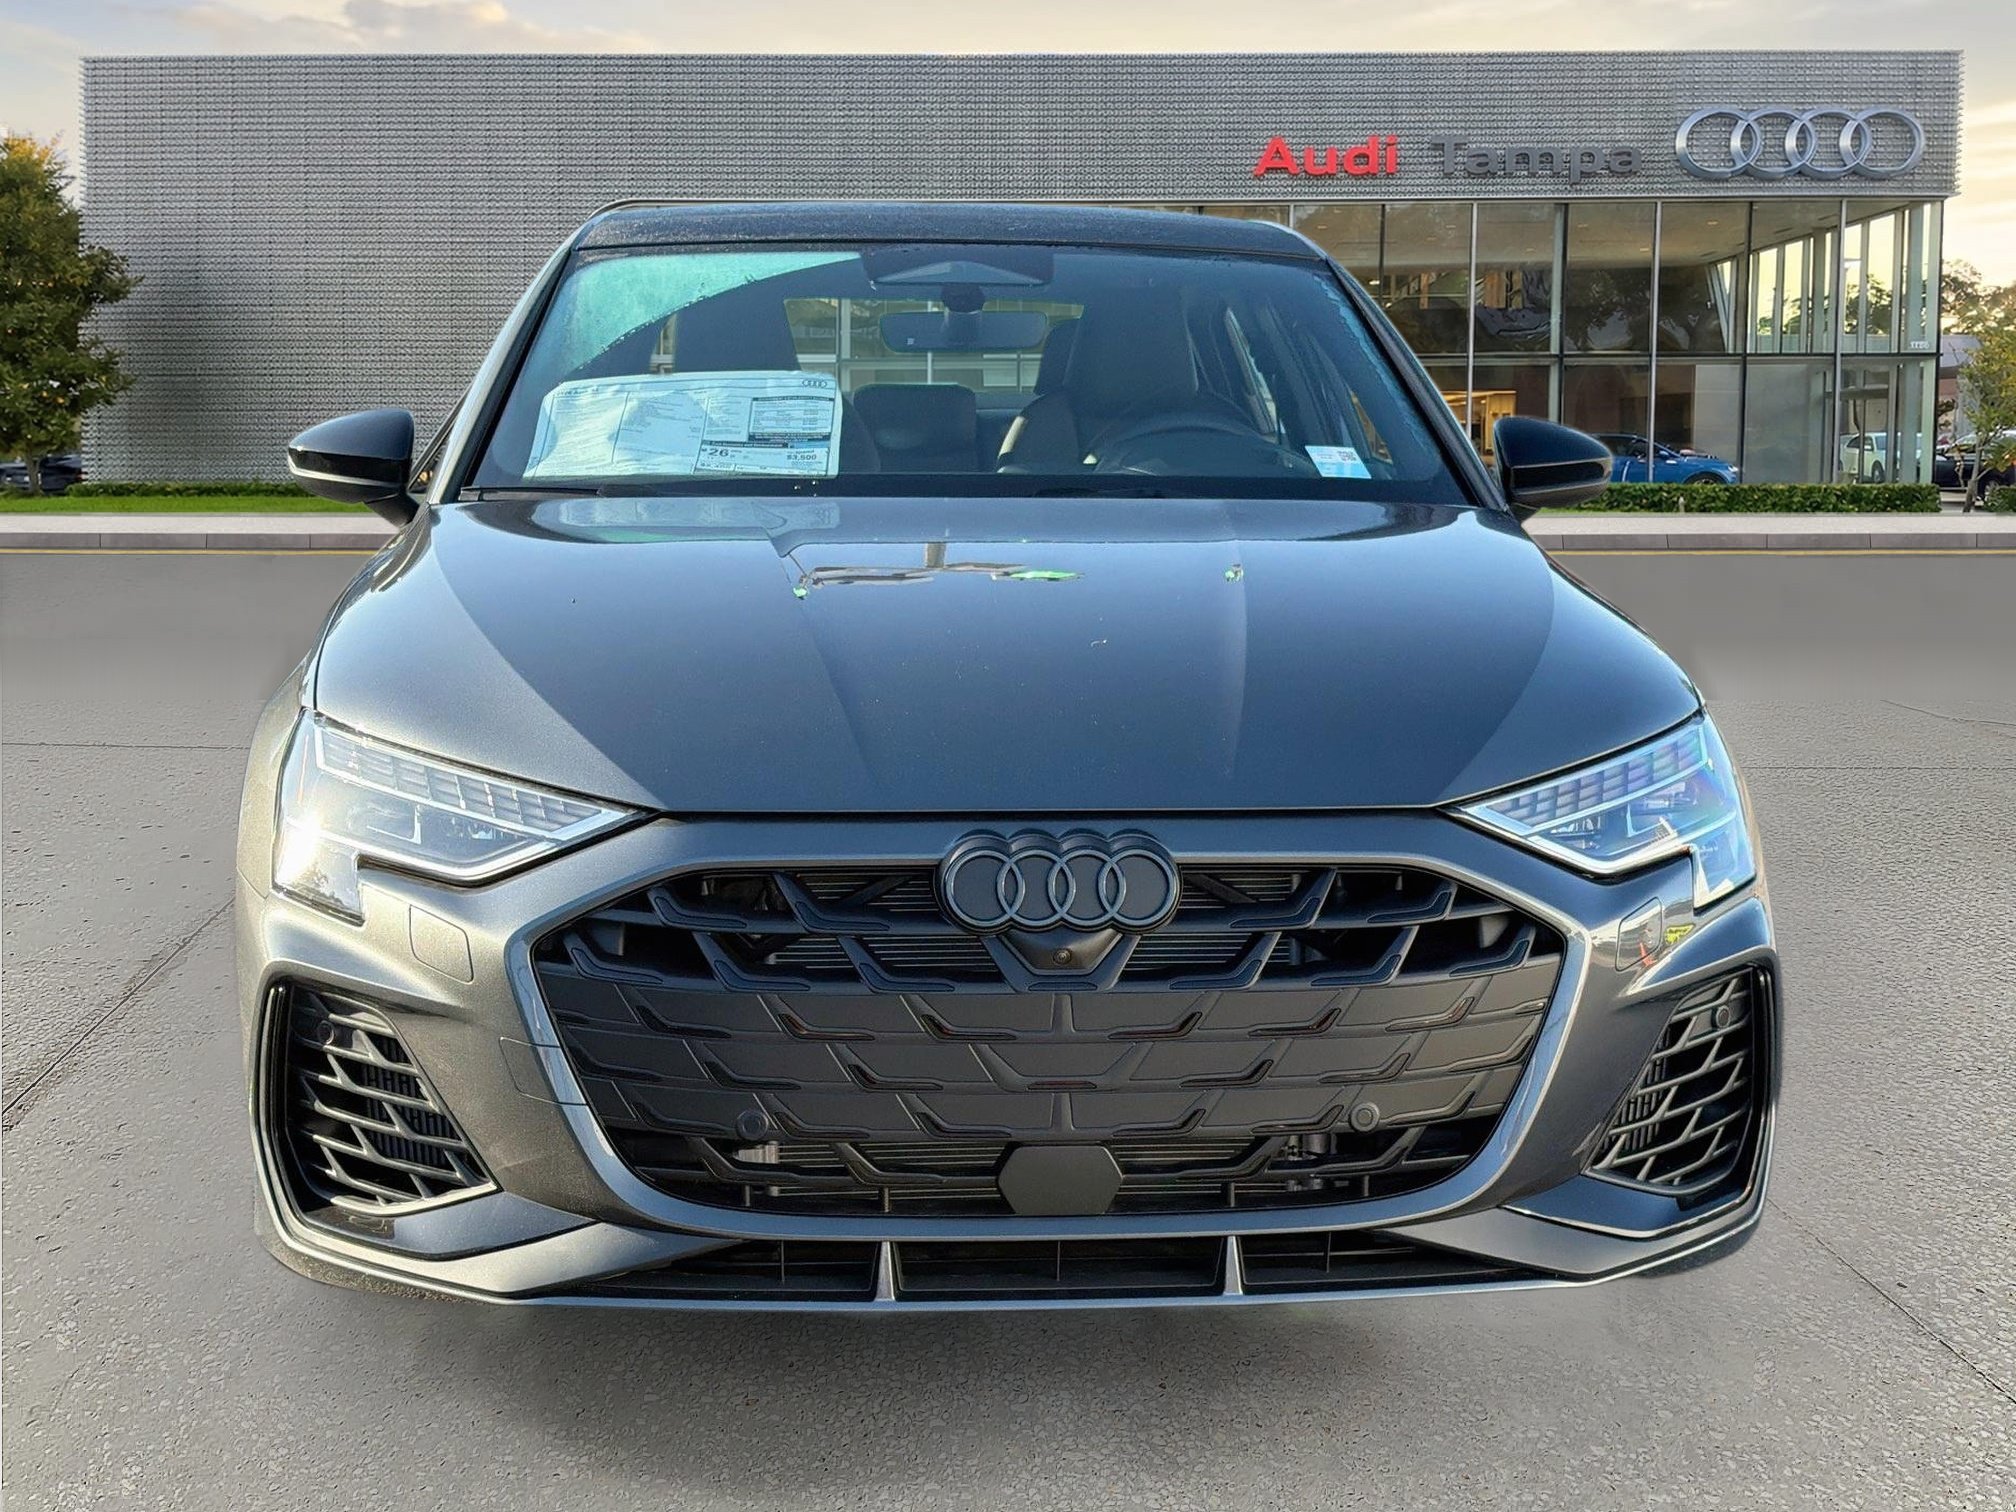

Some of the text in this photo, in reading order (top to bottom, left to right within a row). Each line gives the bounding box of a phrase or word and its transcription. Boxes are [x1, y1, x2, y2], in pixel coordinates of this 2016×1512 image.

[1254, 135, 1642, 185] Audi Tampa
[708, 448, 729, 457] 26
